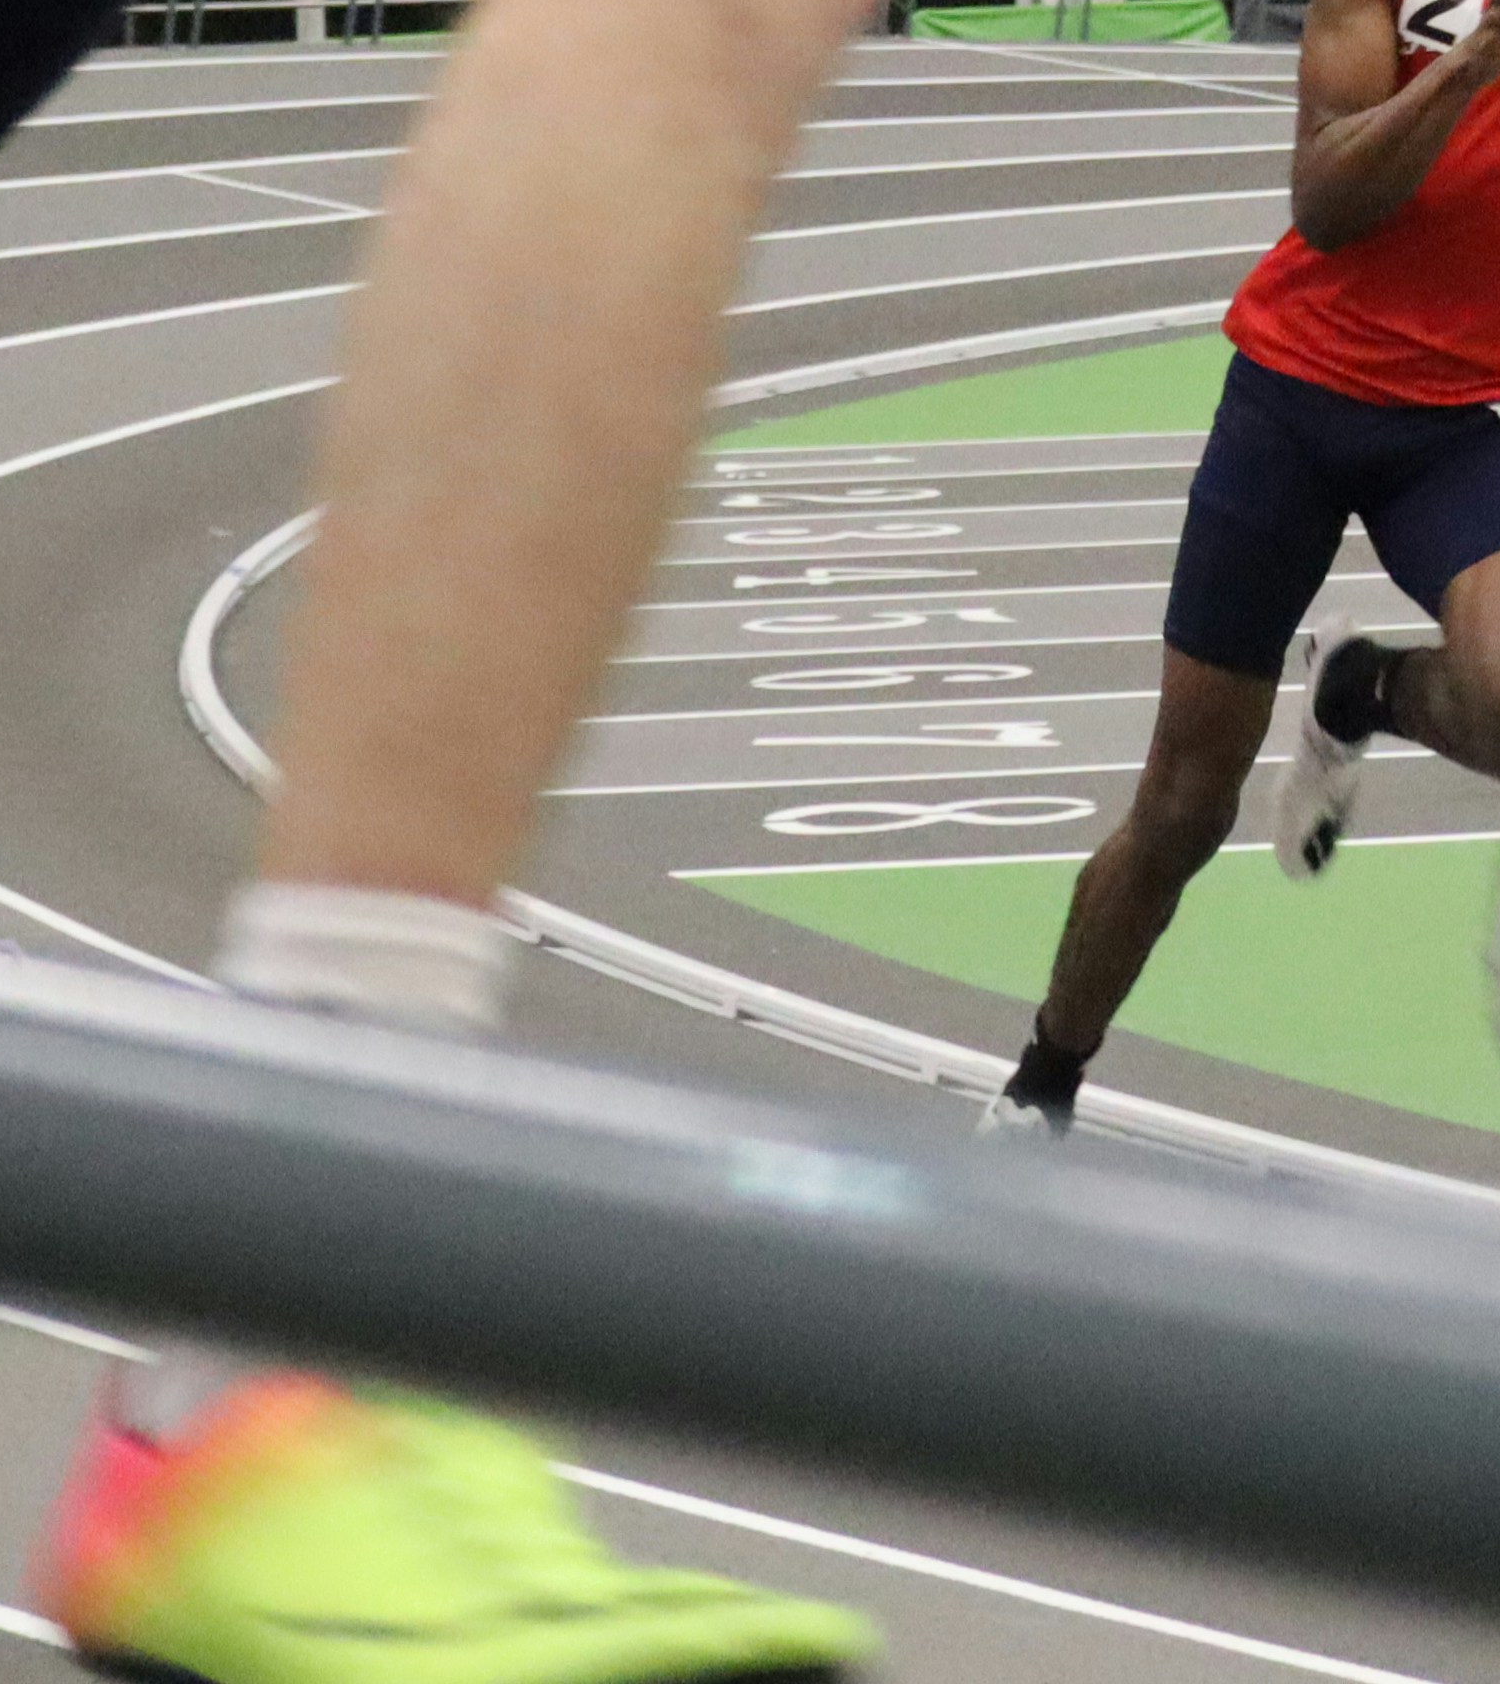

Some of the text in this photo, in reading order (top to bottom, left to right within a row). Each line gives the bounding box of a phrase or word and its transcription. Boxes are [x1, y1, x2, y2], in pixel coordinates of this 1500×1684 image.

[718, 487, 942, 508] 2
[723, 523, 963, 546] 3
[733, 567, 979, 589] 4
[741, 607, 1017, 634] 5
[750, 663, 1034, 691] 6
[752, 720, 1063, 748] 7
[762, 795, 1098, 836] 8
